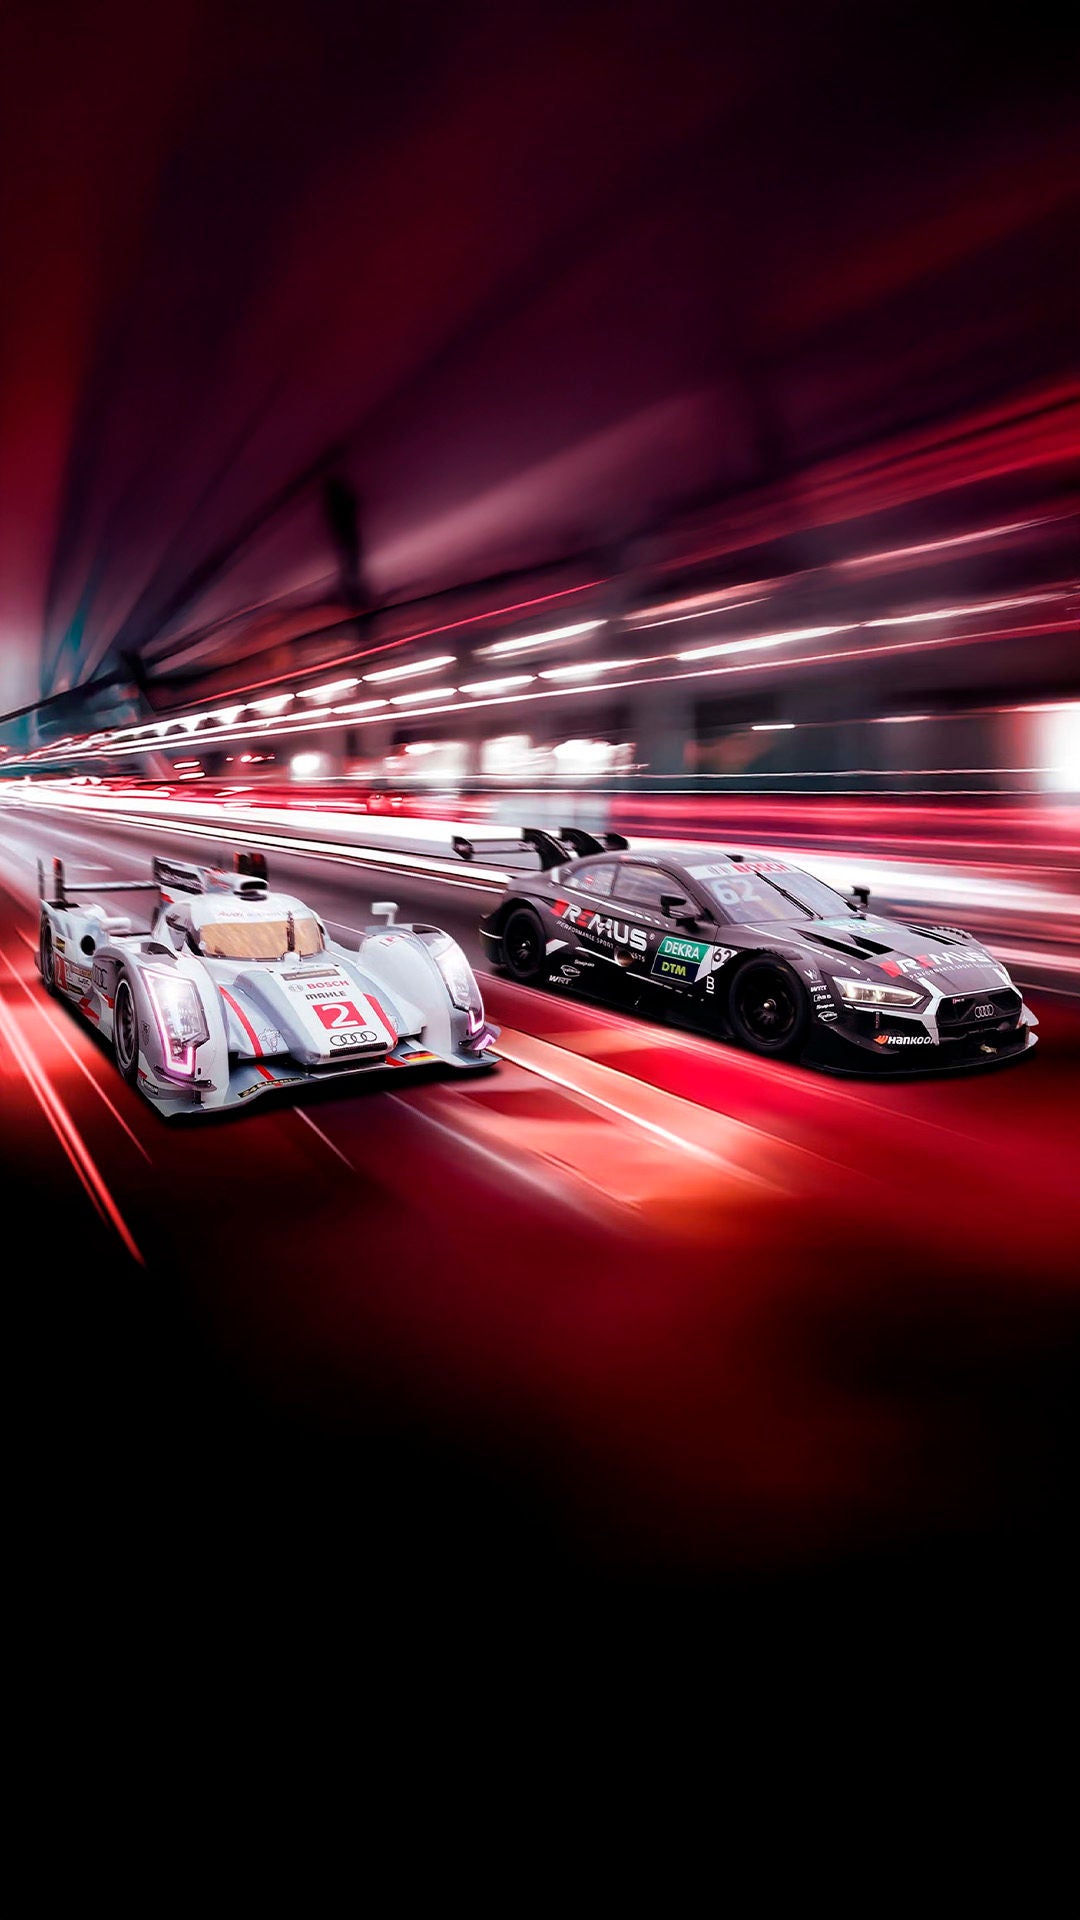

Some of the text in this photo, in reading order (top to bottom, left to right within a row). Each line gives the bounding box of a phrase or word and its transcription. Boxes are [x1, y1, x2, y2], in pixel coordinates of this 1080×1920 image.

[710, 879, 762, 905] 62
[556, 920, 595, 942] PERFORMANCE
[562, 903, 647, 951] REMUS
[664, 940, 700, 960] DEKRA
[661, 961, 687, 977] DTM
[306, 980, 350, 990] BOSCH
[549, 975, 572, 984] WRT
[305, 990, 347, 1001] MAHLE
[321, 1003, 359, 1028] 2
